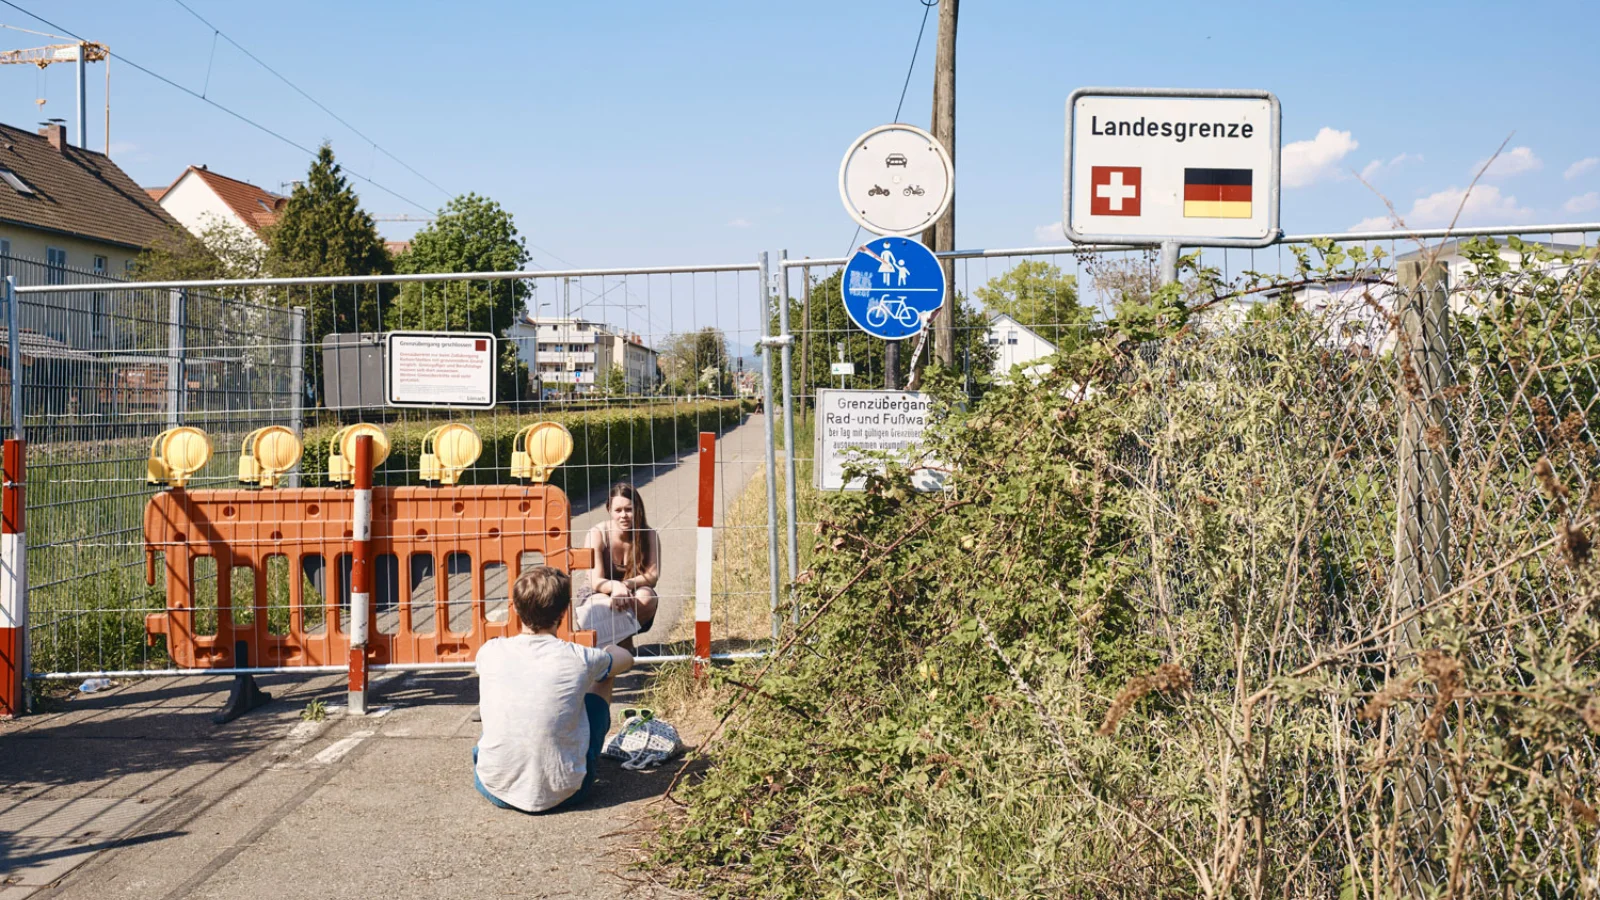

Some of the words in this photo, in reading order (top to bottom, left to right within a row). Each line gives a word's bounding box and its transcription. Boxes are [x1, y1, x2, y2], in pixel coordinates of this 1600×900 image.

[1092, 116, 1254, 142] Landesgrenze
[884, 414, 923, 425] Fußwa
[852, 428, 862, 437] mit
